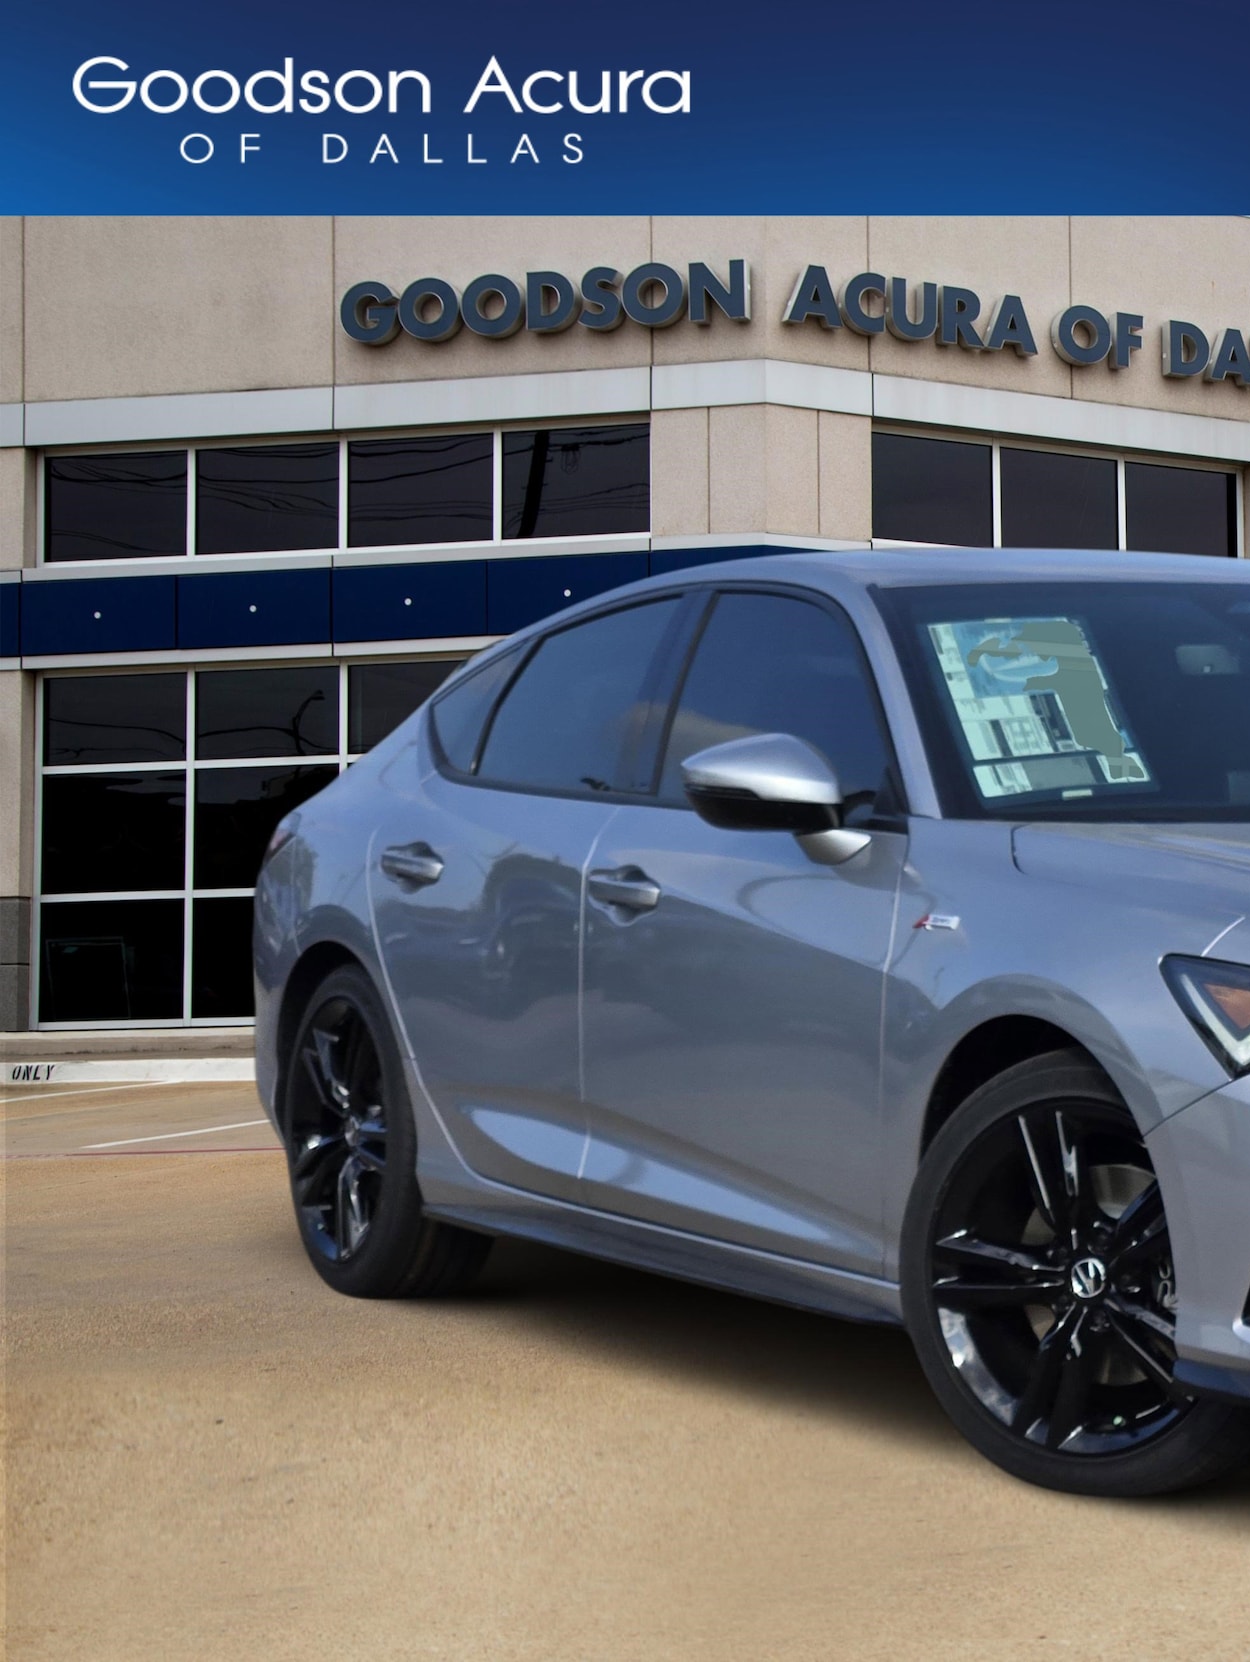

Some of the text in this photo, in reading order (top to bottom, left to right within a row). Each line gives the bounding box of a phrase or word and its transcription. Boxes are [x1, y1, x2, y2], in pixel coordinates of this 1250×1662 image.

[340, 259, 750, 345] GOODSON
[784, 264, 1038, 357] ACURA
[1051, 305, 1144, 369] OF
[12, 1064, 55, 1081] ONLY
